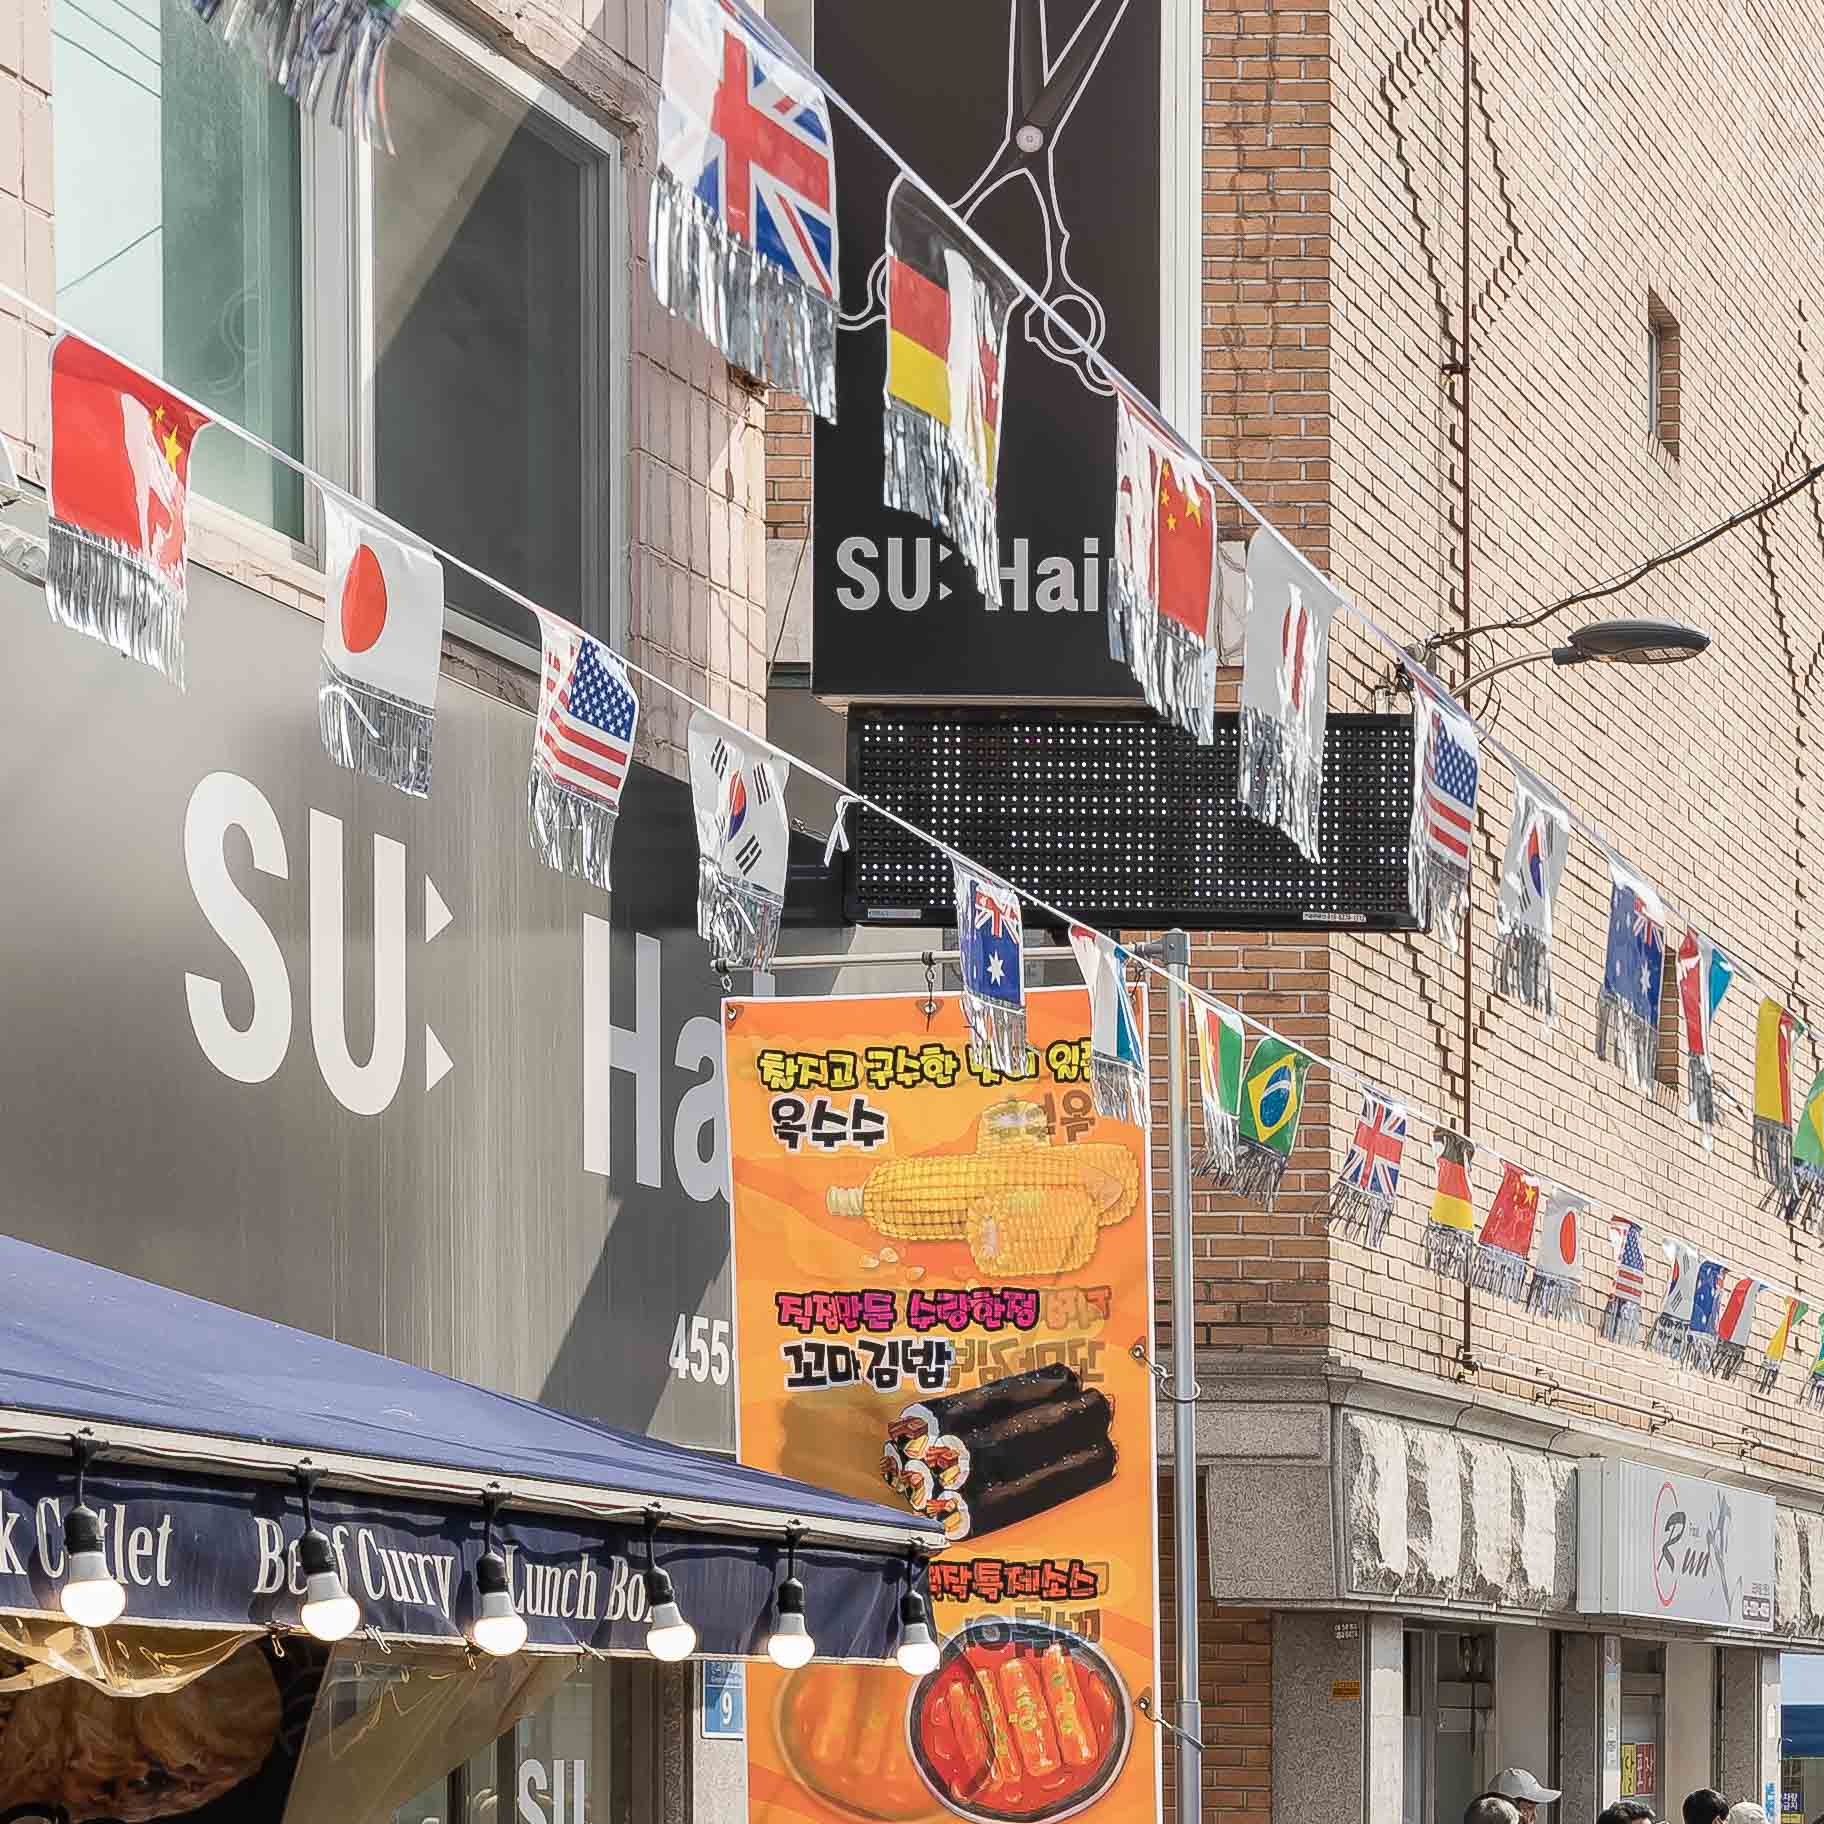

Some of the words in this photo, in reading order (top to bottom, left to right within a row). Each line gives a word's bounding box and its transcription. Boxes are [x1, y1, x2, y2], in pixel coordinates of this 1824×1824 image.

[984, 535, 1115, 612] Hai
[864, 1043, 961, 1090] 구수한
[769, 1093, 889, 1152] 옥수수
[780, 1337, 954, 1392] 꼬마김밥
[36, 1496, 174, 1590] Ctlet
[253, 1516, 350, 1600] Bef
[353, 1525, 455, 1630] Curry
[607, 1554, 660, 1625] Bo
[720, 1691, 734, 1726] 9
